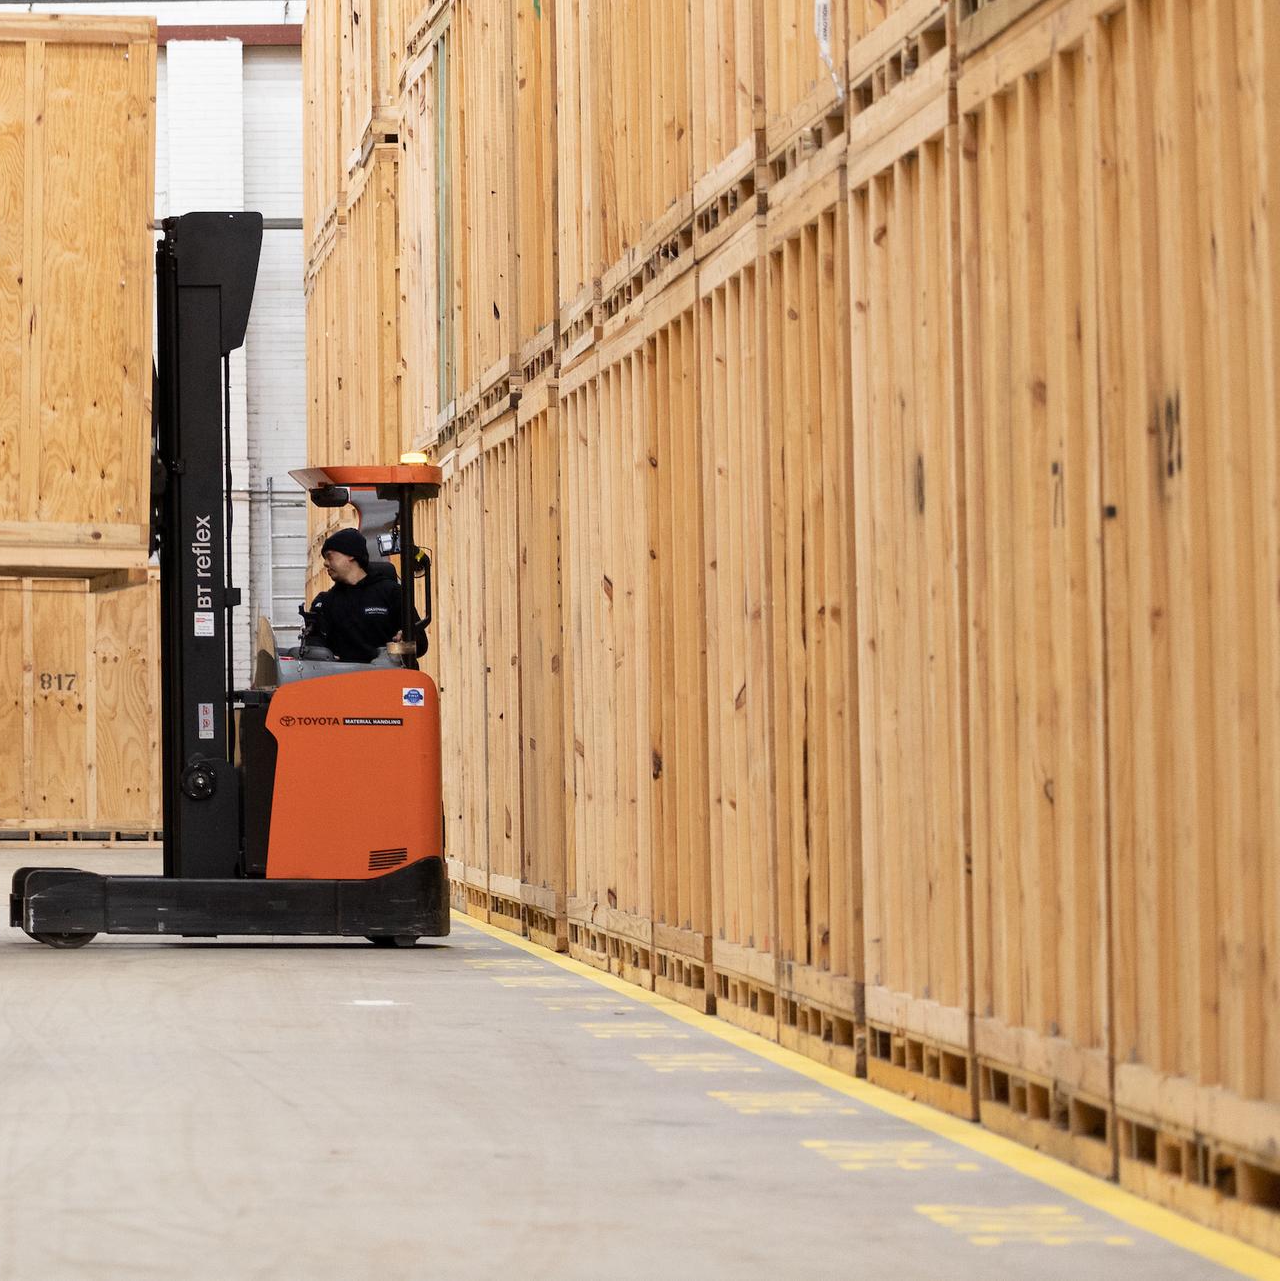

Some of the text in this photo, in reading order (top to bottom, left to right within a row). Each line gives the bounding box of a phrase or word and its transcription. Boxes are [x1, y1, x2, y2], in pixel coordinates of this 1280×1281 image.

[191, 514, 212, 578] reflex
[196, 584, 212, 609] BT
[40, 673, 76, 691] 817
[297, 717, 340, 726] TOYOTA
